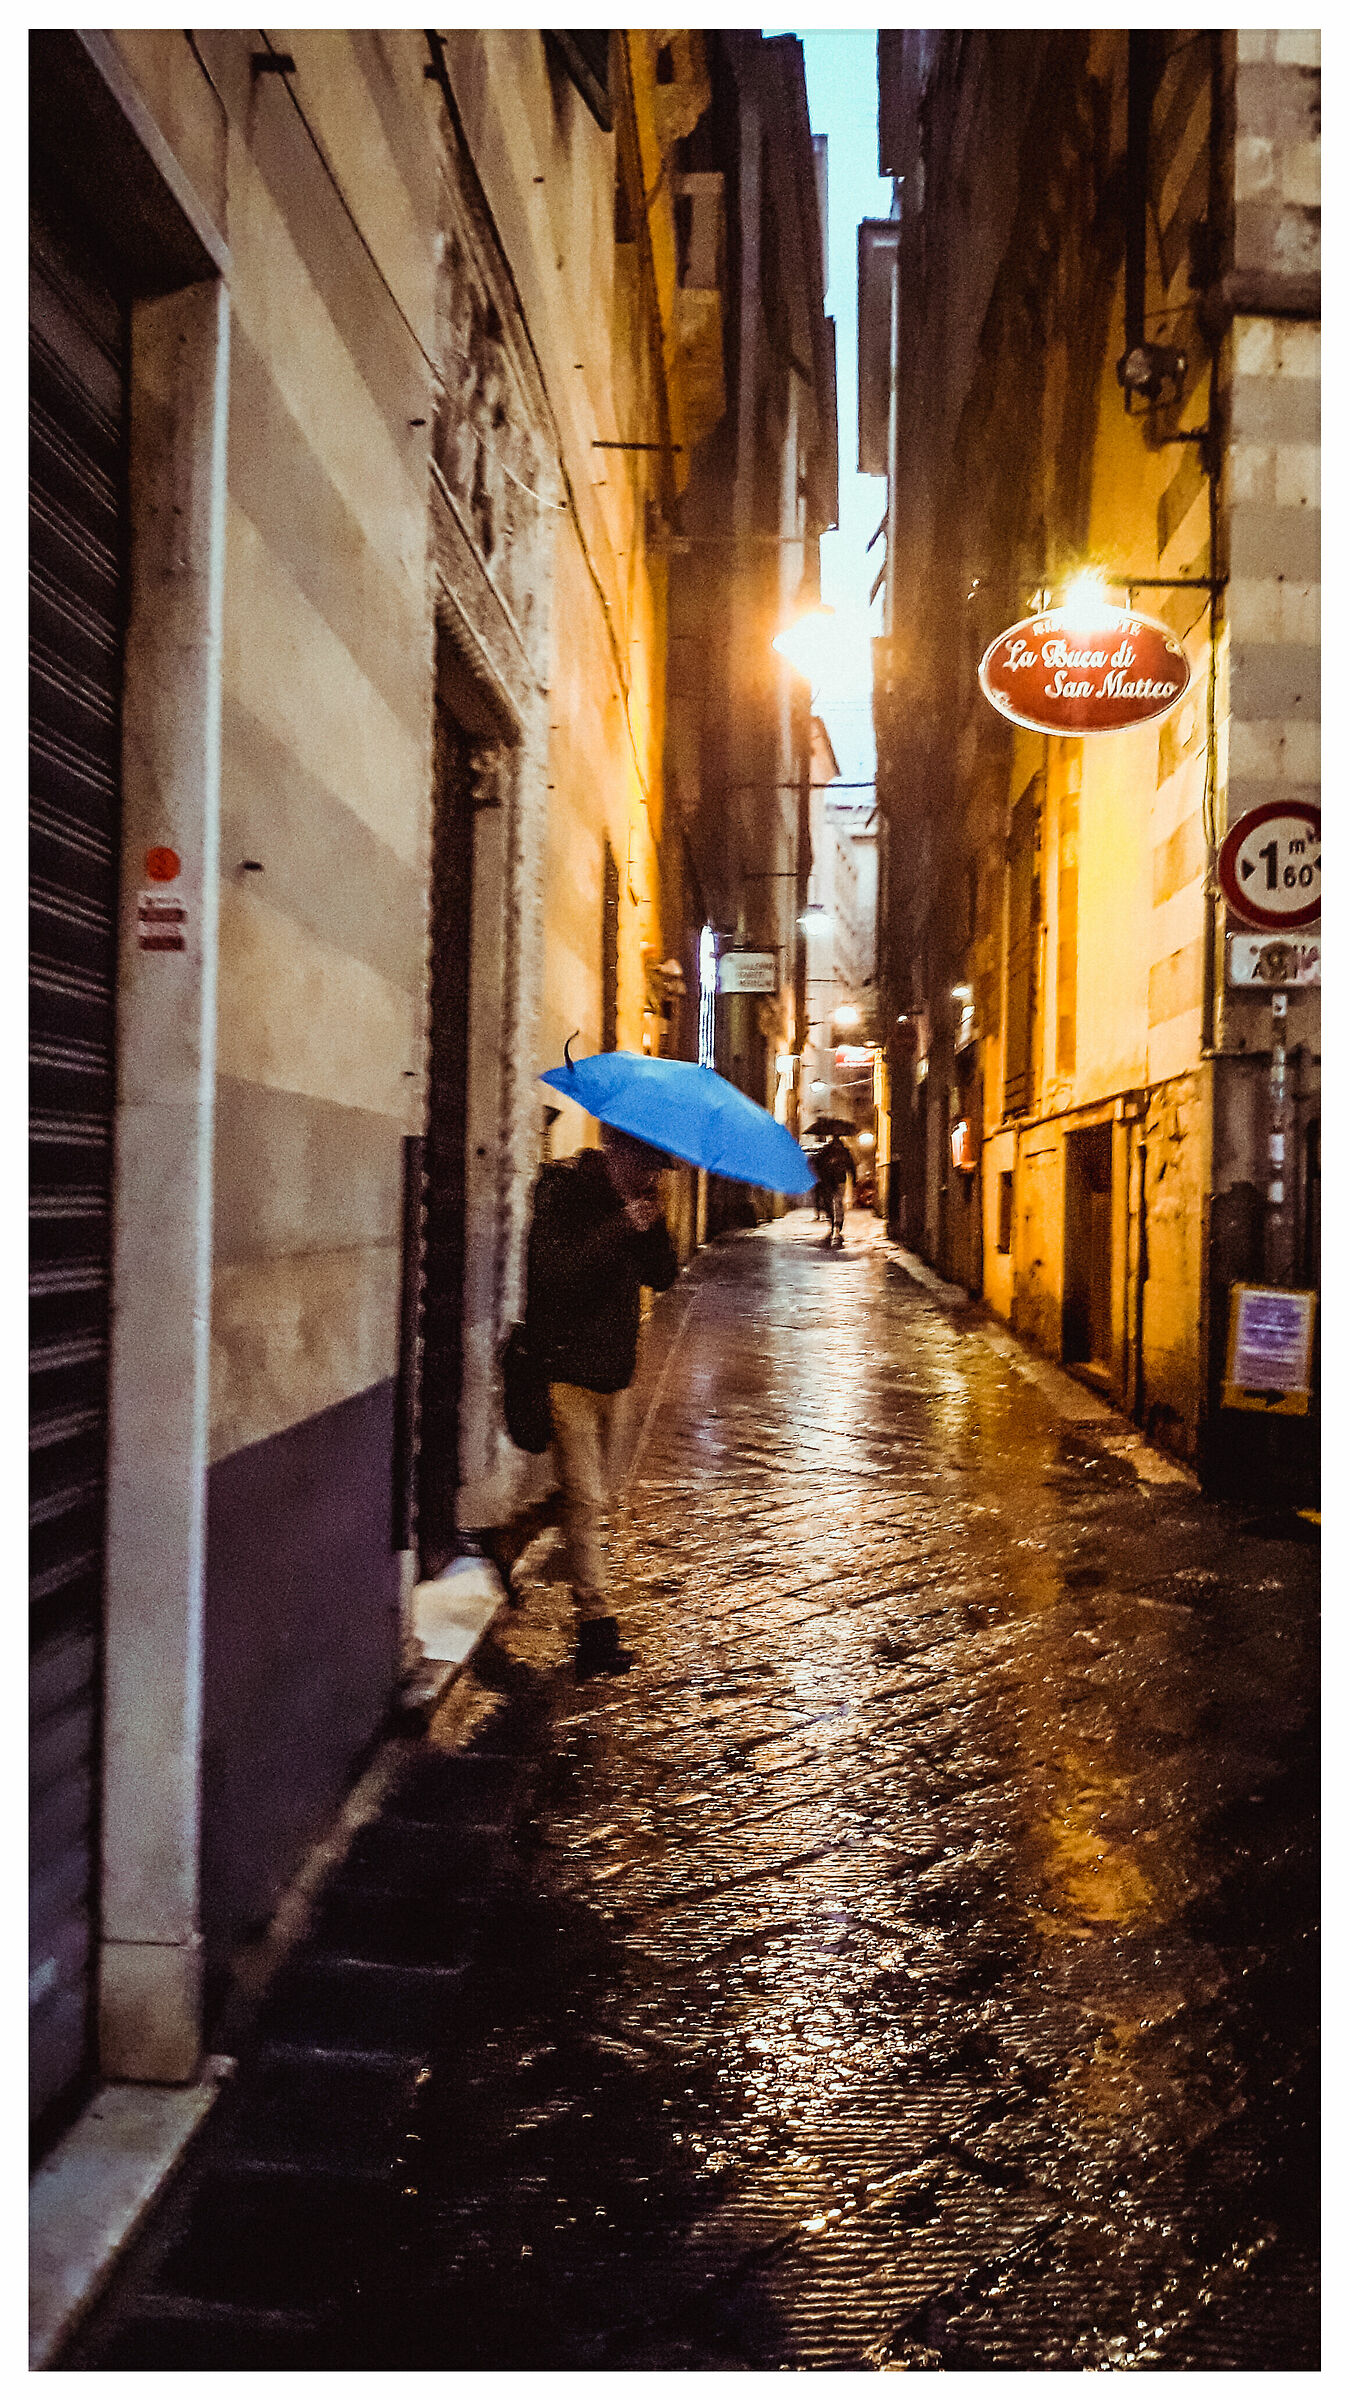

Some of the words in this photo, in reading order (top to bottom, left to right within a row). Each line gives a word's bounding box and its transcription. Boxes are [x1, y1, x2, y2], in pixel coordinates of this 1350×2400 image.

[1003, 639, 1037, 672] La
[1041, 639, 1107, 669] Buca
[1110, 639, 1136, 669] di
[1044, 670, 1095, 699] San
[1095, 669, 1178, 700] Matteo
[1259, 840, 1278, 890] 1
[1284, 866, 1313, 888] 60
